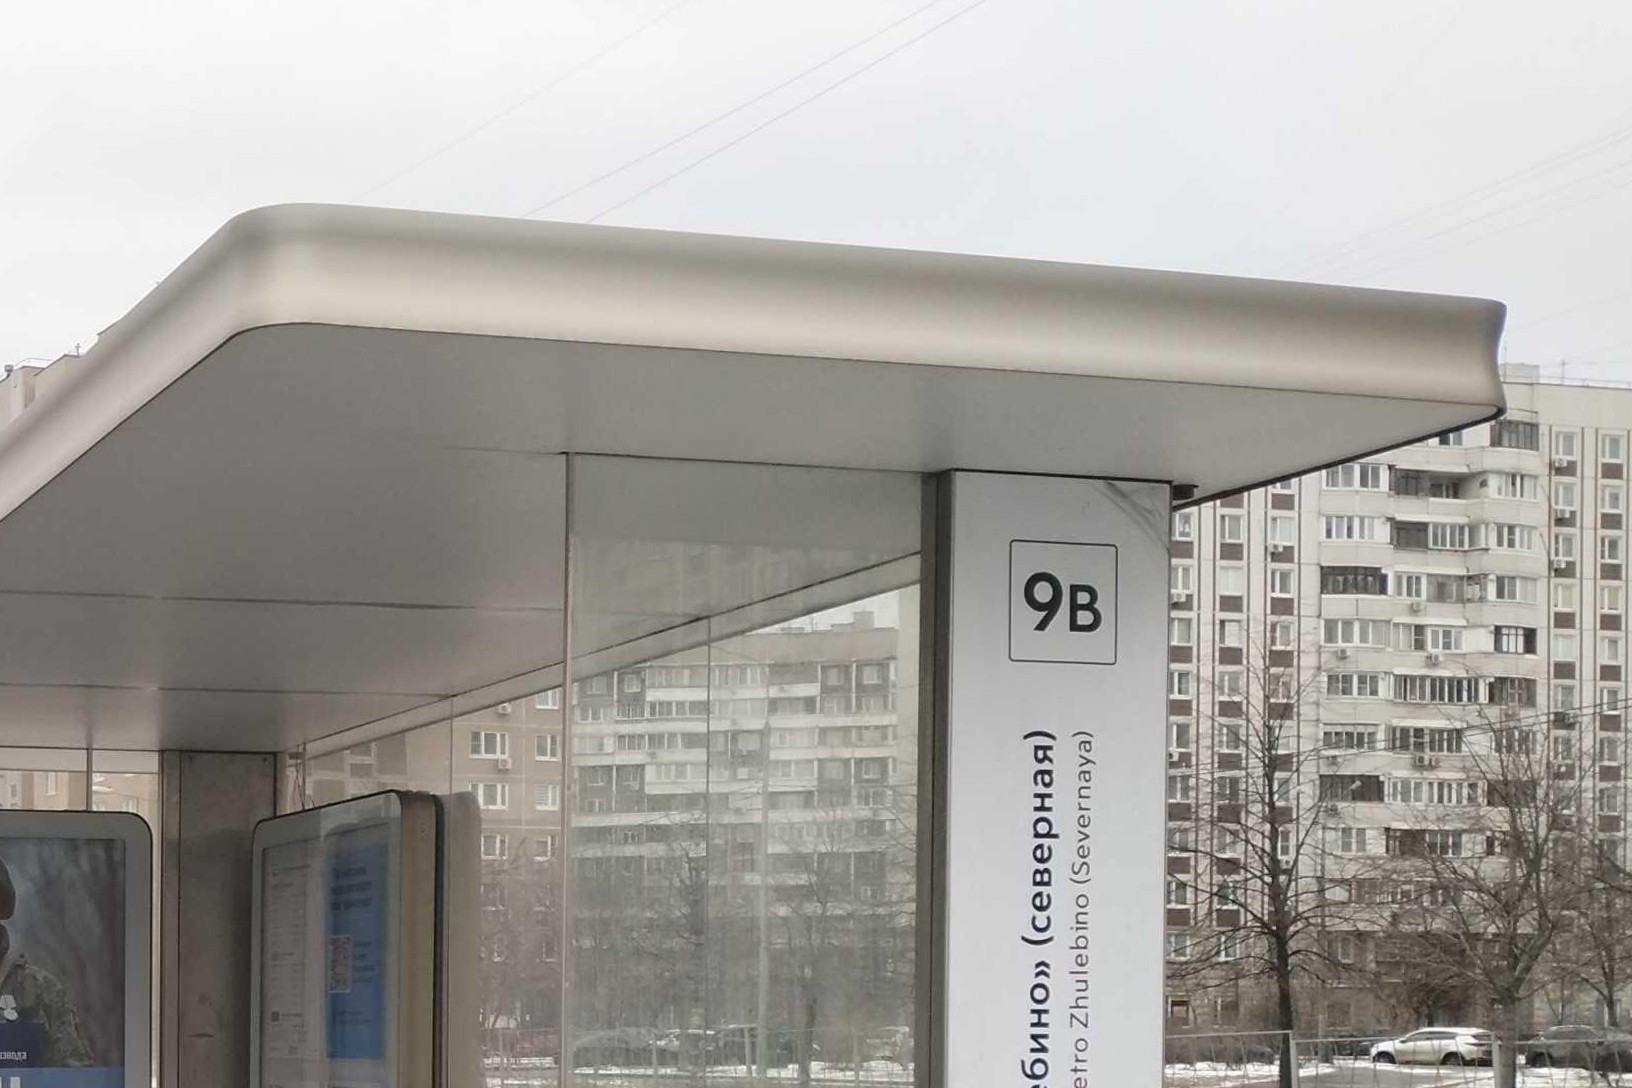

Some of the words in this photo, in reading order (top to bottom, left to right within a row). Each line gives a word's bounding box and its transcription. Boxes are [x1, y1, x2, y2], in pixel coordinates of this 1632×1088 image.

[1020, 730, 1060, 947] (северная)
[1068, 730, 1096, 886] (Severnaya)
[1068, 895, 1090, 1029] Zhulebino
